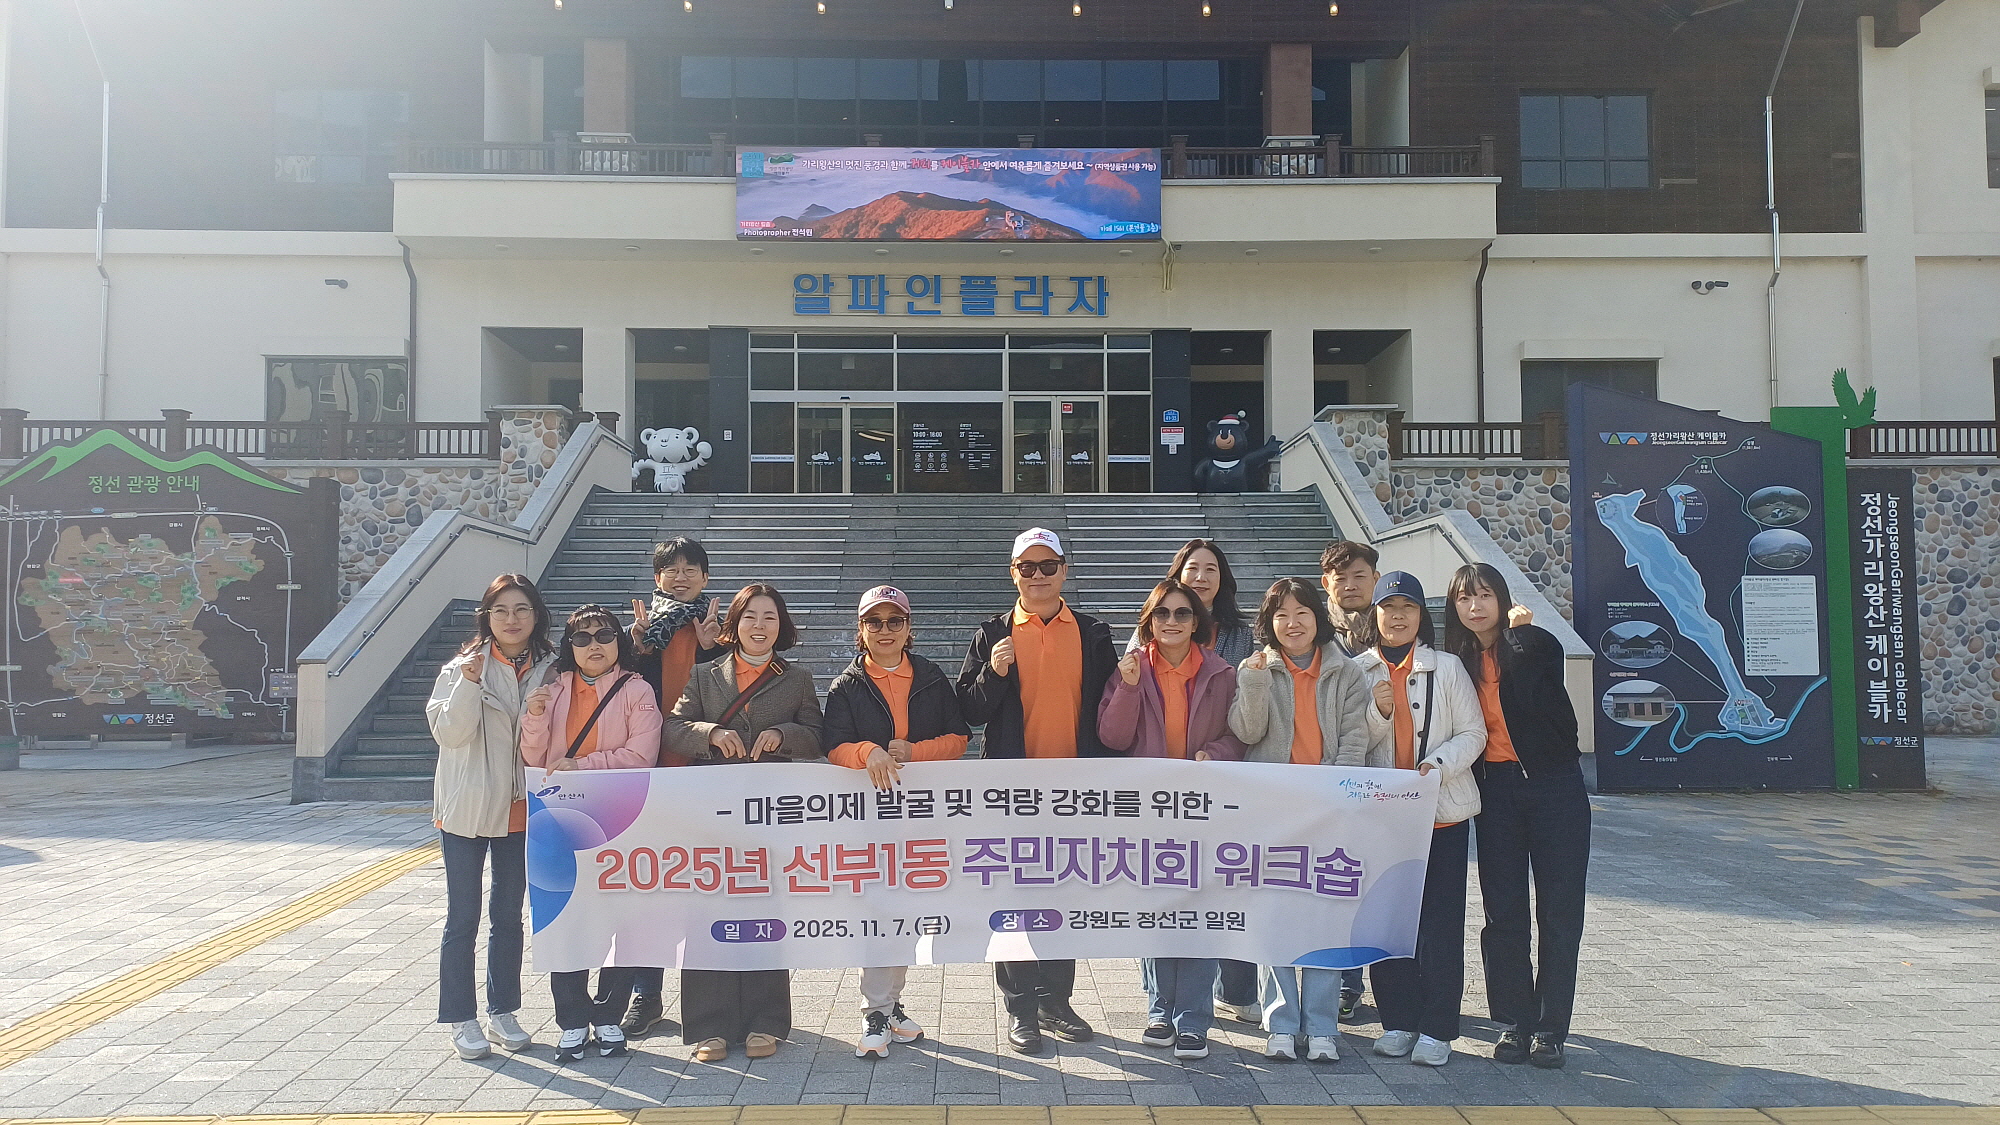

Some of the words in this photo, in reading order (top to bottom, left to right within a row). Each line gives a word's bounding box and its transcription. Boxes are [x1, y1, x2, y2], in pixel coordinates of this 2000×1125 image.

[801, 160, 843, 171] 가리왕산의
[845, 160, 862, 171] 멋진
[864, 160, 888, 171] 풍경과
[890, 160, 908, 171] 함께
[940, 156, 981, 173] 케이블카
[982, 161, 1008, 171] 안에서
[1009, 161, 1042, 171] 여유롭게
[1044, 161, 1085, 171] 즐겨보세요
[792, 273, 1110, 317] 알파인플라자
[1650, 432, 1696, 442] 정선가리왕산
[1697, 432, 1727, 442] 케이블카
[88, 475, 121, 493] 정선
[126, 475, 161, 493] 관광
[166, 475, 200, 493] 안내
[1860, 492, 1888, 628] 정선가리왕산
[1886, 493, 1904, 659] JeongseonGariwangsan
[1865, 634, 1892, 724] 케이블카
[1894, 663, 1909, 724] cablecar
[144, 713, 176, 724] 정선군
[1894, 736, 1919, 746] 정선군
[557, 791, 586, 801] 안산시
[744, 792, 866, 826] 마을의제
[875, 788, 936, 821] 발굴
[945, 788, 973, 817] 및
[982, 787, 1043, 817] 역량
[1050, 787, 1141, 819] 강화를
[1151, 789, 1213, 821] 위한
[1401, 791, 1422, 800] 안산
[594, 845, 771, 896] 2025년
[782, 837, 952, 894] 선부1동
[961, 836, 1199, 890] 주민자치회
[1213, 842, 1364, 898] 워크숍
[1068, 909, 1131, 931] 강원도
[1136, 910, 1200, 931] 정선군
[1204, 910, 1247, 932] 일원
